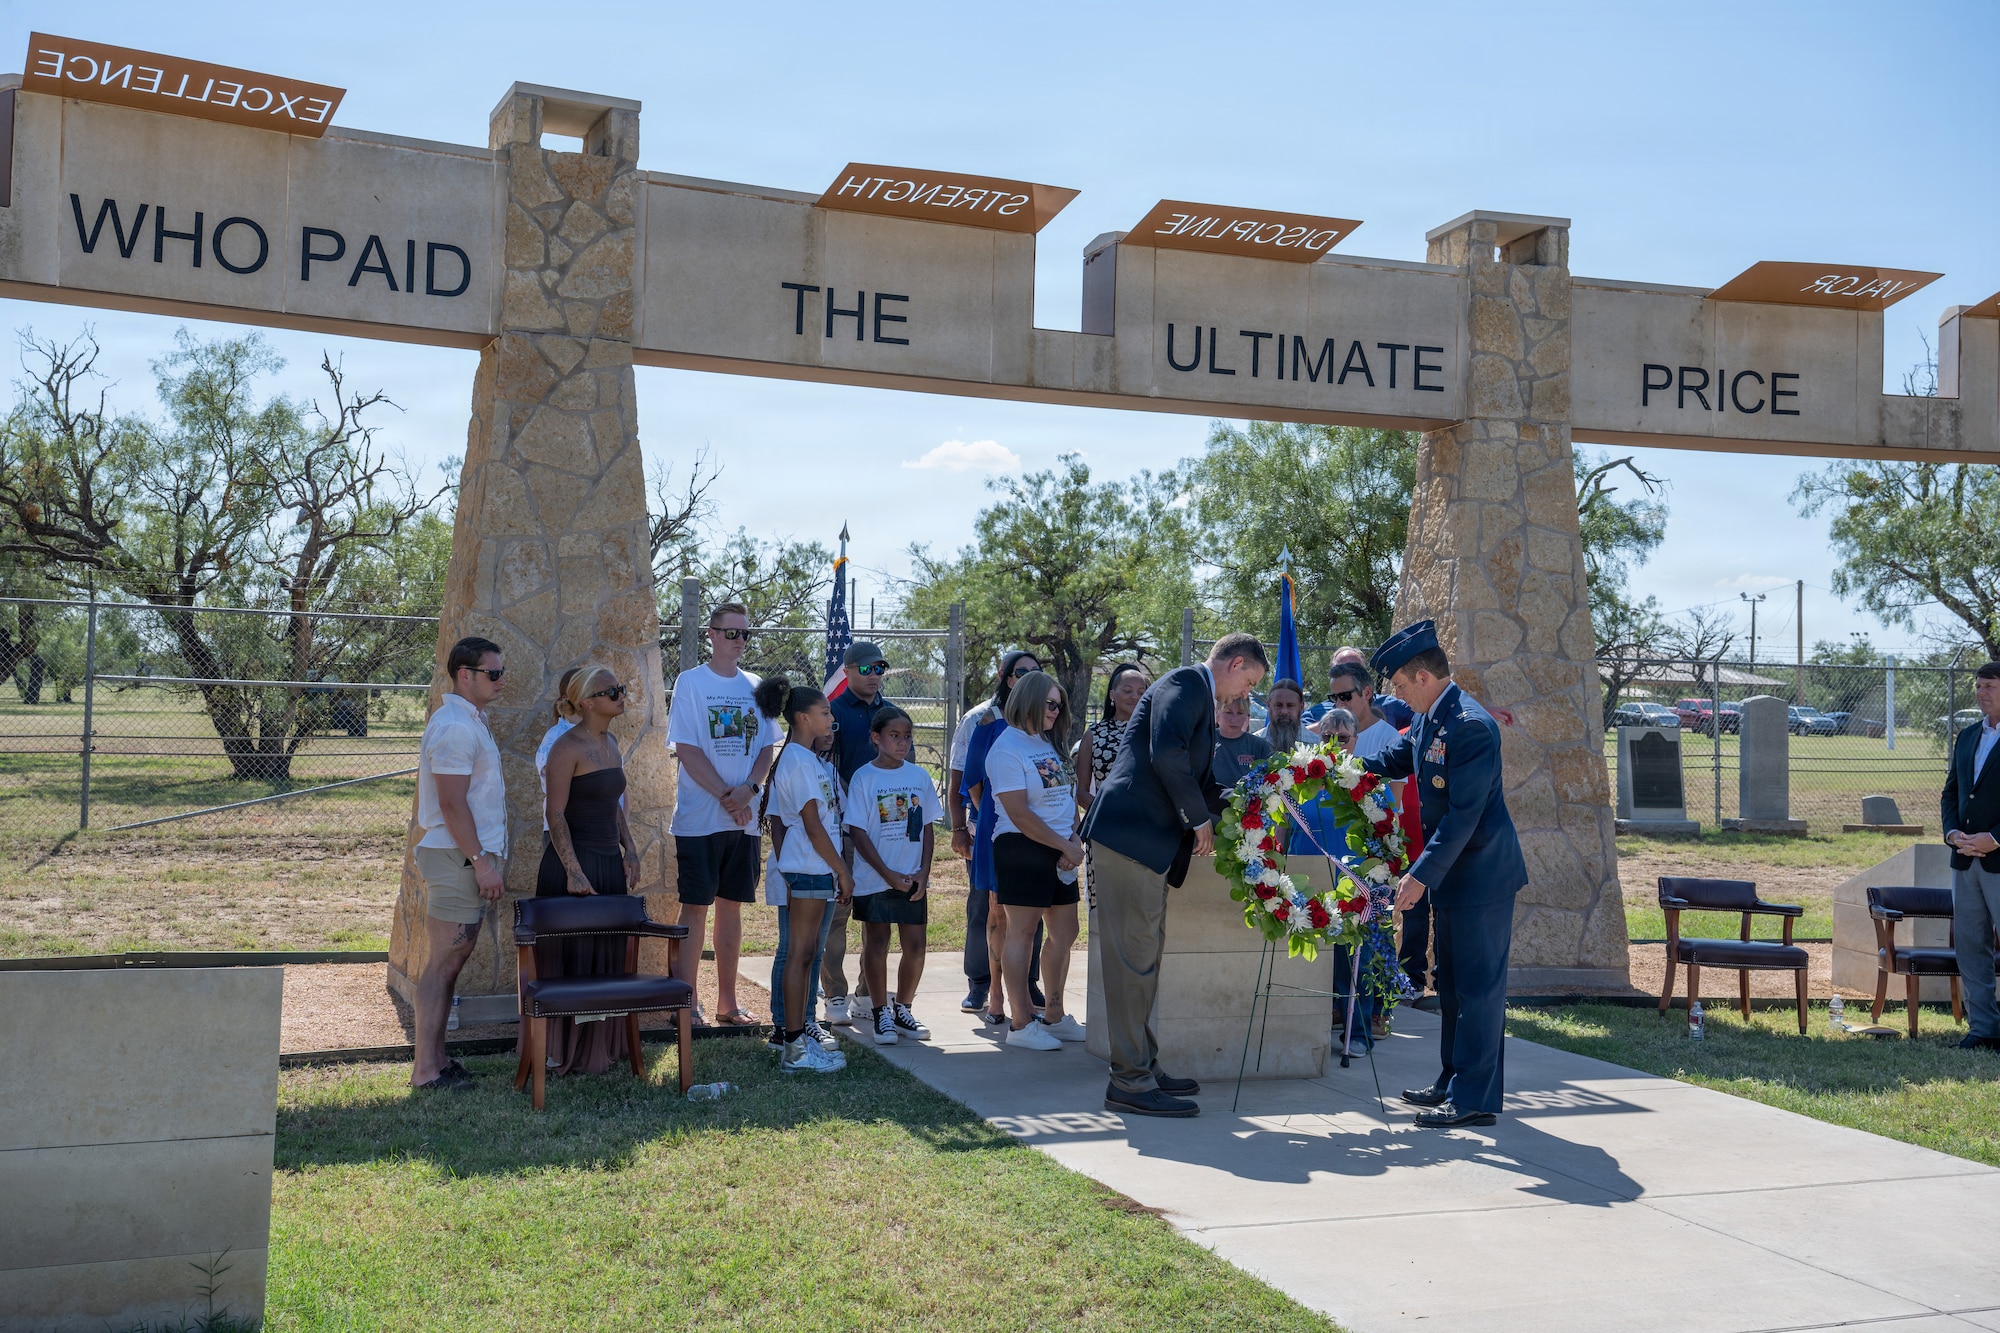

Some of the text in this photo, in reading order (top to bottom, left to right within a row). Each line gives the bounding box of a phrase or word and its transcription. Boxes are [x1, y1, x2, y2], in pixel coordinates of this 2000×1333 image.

[70, 193, 472, 298] WHO PAID
[781, 282, 1445, 393] THE ULTIMATE
[1642, 363, 1801, 415] PRICE
